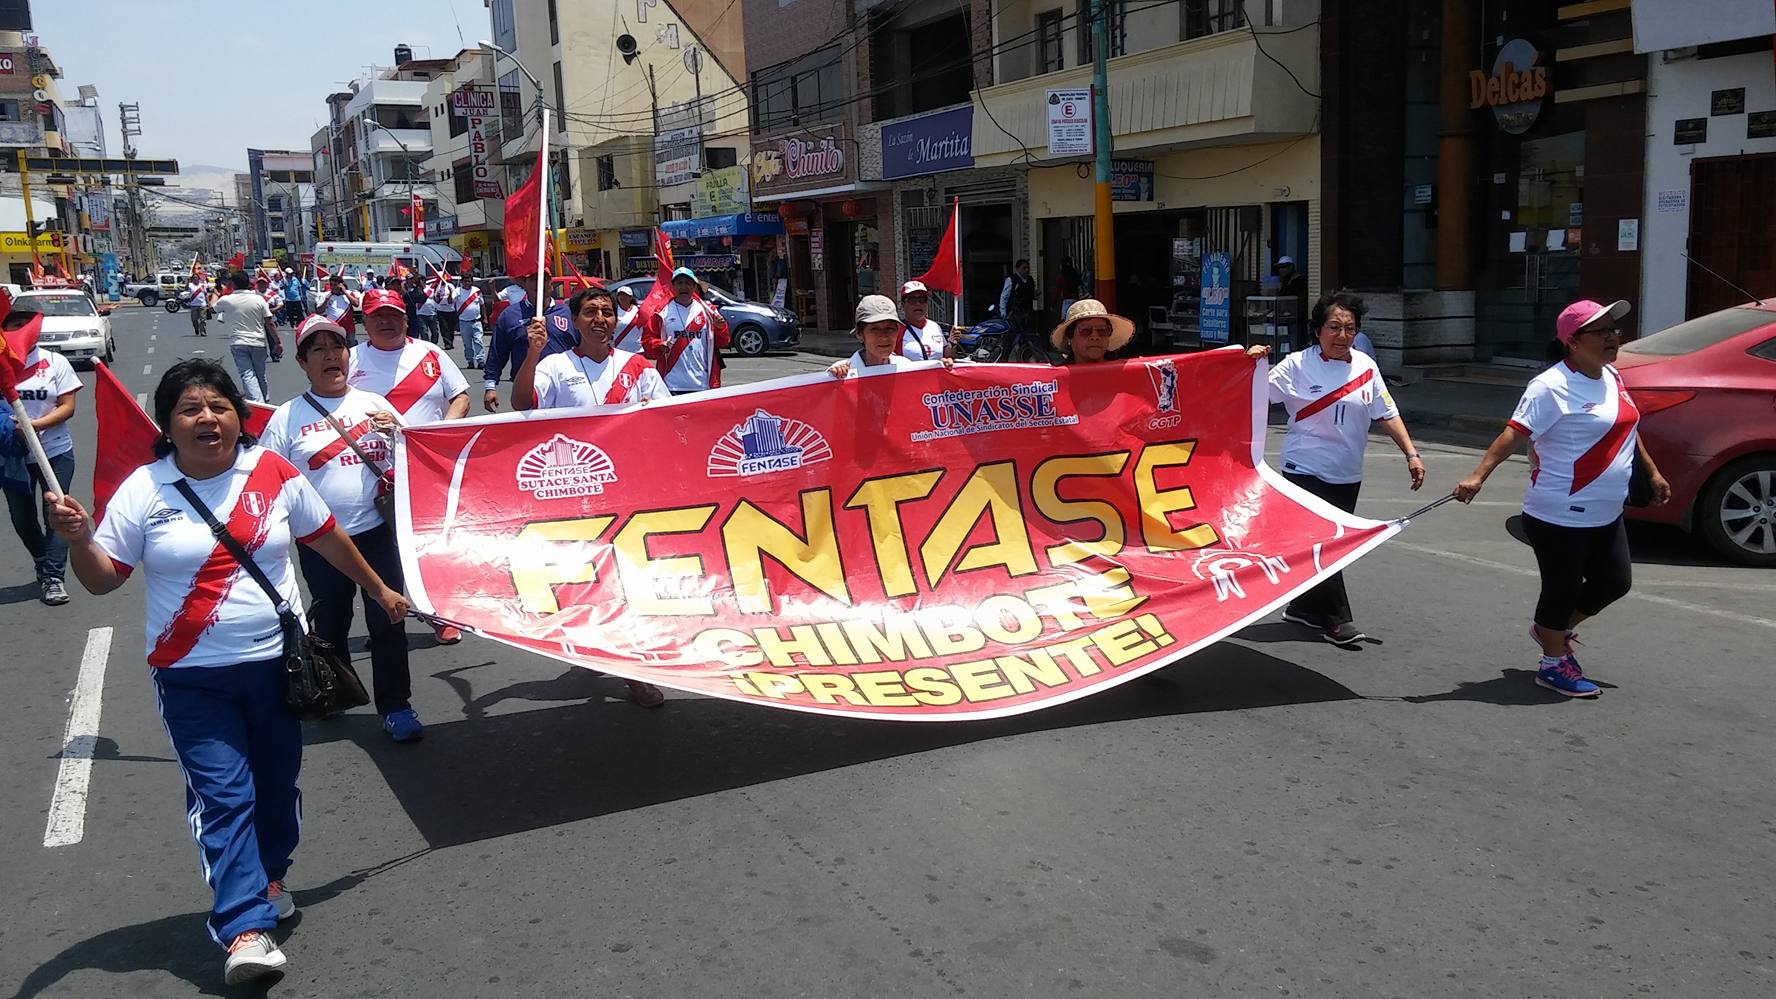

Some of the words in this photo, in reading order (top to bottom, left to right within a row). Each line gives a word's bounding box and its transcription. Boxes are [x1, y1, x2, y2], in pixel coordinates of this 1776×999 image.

[454, 91, 494, 107] CLINICA
[1065, 105, 1073, 115] E
[462, 108, 489, 116] JUAN
[471, 118, 487, 178] PABLO
[785, 137, 844, 178] Chinito
[915, 130, 970, 164] Martita
[922, 385, 1009, 406] Confederación
[1010, 379, 1058, 397] Sindical
[931, 393, 1057, 429] UNASSE
[911, 430, 933, 442] Unión
[933, 427, 965, 439] Nacional
[965, 425, 975, 434] de
[976, 422, 1014, 432] Sindicatos
[1015, 420, 1028, 428] del
[1028, 417, 1052, 427] Sector
[1053, 415, 1078, 425] Estatal
[1149, 415, 1182, 431] CGTP
[541, 464, 589, 478] FENTASE
[741, 455, 798, 474] FENTASE
[520, 476, 571, 490] SUTACE
[572, 471, 616, 486] SANTA
[536, 484, 602, 499] CHIMBOTE
[150, 516, 184, 527] UMBRO
[508, 440, 1221, 617] FENTASE
[692, 566, 1151, 668] CHIMBOTE
[730, 612, 1179, 708] ¡PRESENTE!
